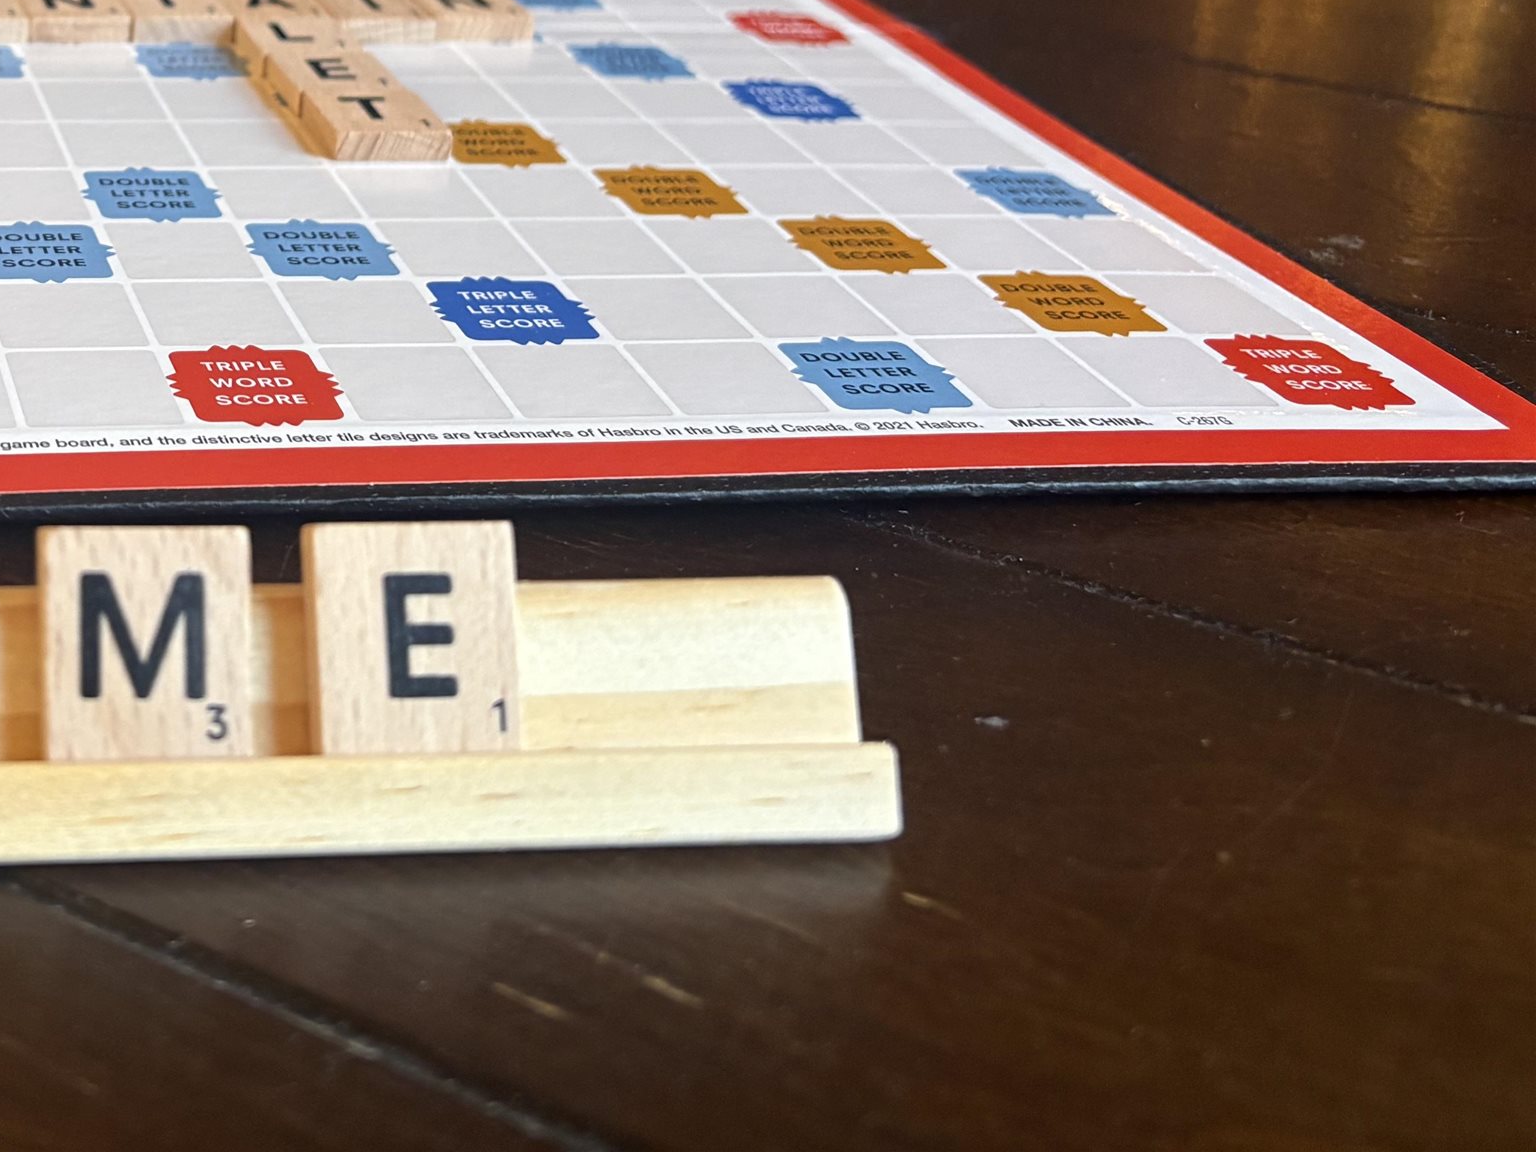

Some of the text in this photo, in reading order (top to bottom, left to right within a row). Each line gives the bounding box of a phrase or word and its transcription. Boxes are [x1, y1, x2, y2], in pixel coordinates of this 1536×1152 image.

[99, 178, 189, 186] DOUBLE
[111, 189, 189, 198] LETTER
[117, 200, 195, 209] SCORE
[263, 231, 360, 240] DOUBLE
[798, 226, 890, 236] DOUBLE
[822, 238, 893, 247] WORD
[278, 243, 361, 253] LETTER
[834, 250, 914, 260] SCORE
[2, 258, 86, 268] SCORE
[287, 256, 370, 265] SCORE
[1000, 283, 1097, 293] DOUBLE
[457, 290, 536, 300] TRIPLE
[1028, 296, 1104, 306] WORD
[467, 304, 552, 314] LETTER
[1045, 310, 1130, 320] SCORE
[479, 318, 564, 329] SCORE
[800, 351, 906, 362] DOUBLE
[1240, 348, 1322, 359] TRIPLE
[200, 360, 285, 372] TRIPLE
[1263, 364, 1342, 374] WORD
[824, 366, 917, 378] LETTER
[210, 377, 292, 388] WORD
[1286, 379, 1372, 391] SCORE
[842, 383, 934, 395] SCORE
[216, 394, 307, 406] SCORE
[1007, 417, 1154, 428] MADE IN CHINA.
[0, 441, 51, 451] game
[55, 437, 114, 448] board,
[119, 436, 153, 446] and
[157, 436, 187, 446] the
[191, 434, 283, 445] distinctive
[286, 433, 333, 443] letter
[336, 432, 365, 442] tile
[369, 431, 439, 443] designs
[442, 432, 471, 440] are
[473, 429, 574, 439] trademarks
[577, 428, 595, 438] of
[597, 427, 662, 437] Hasbro
[663, 426, 683, 436] in
[683, 426, 713, 435] the
[714, 425, 744, 435] US
[746, 424, 780, 434] and
[781, 423, 853, 433] Canada.
[872, 421, 914, 431] 2021
[915, 420, 984, 430] Hasbro.
[205, 704, 229, 740] 3
[491, 698, 508, 732] 1
